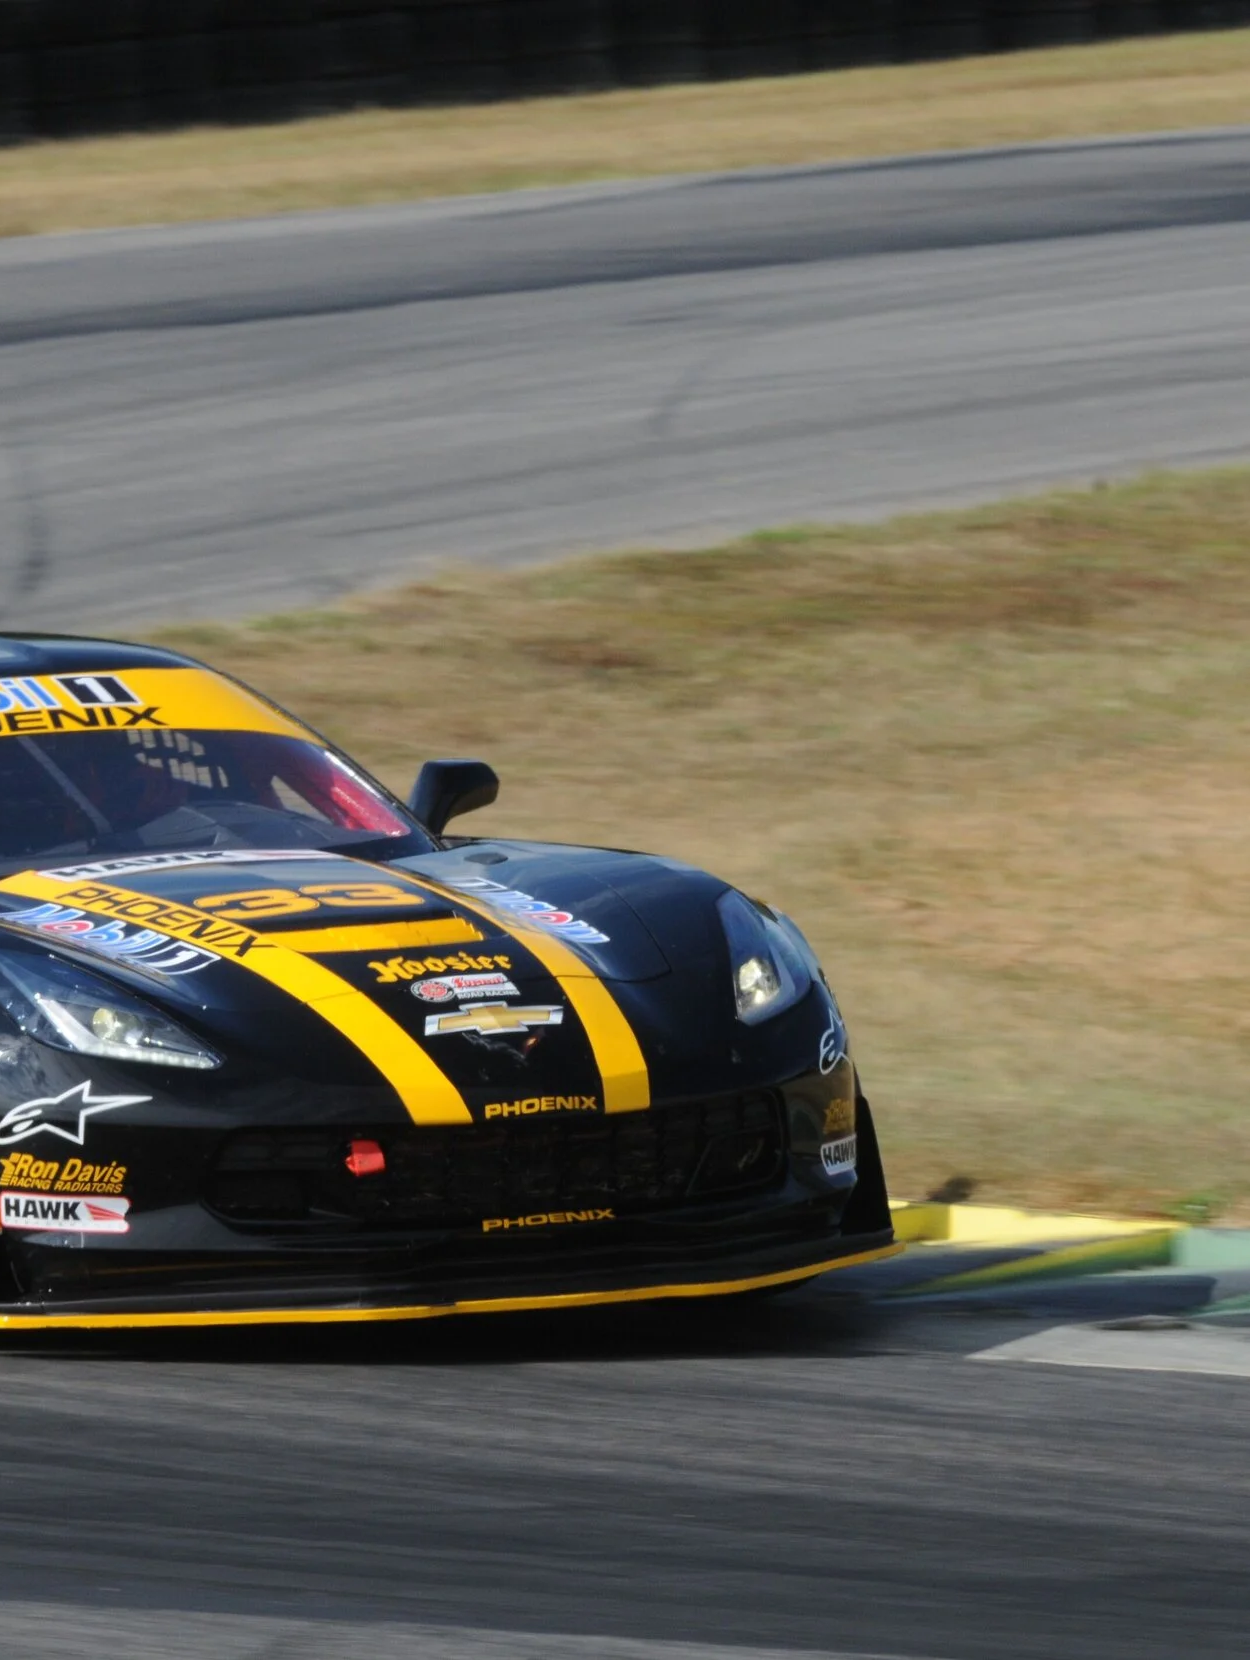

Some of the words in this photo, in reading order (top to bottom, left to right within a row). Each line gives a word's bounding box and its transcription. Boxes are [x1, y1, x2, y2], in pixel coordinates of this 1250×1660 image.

[69, 675, 119, 705] 1
[194, 883, 424, 919] 33
[55, 886, 279, 958] PHOENIX
[367, 951, 512, 983] Hoosier
[485, 1096, 597, 1119] PHOENIX
[16, 1153, 59, 1180] Ron
[60, 1158, 127, 1184] Davis
[10, 1176, 52, 1191] RACING
[54, 1180, 123, 1194] RADIATORS
[4, 1198, 81, 1221] HAWK
[482, 1208, 615, 1232] PHOENIX
